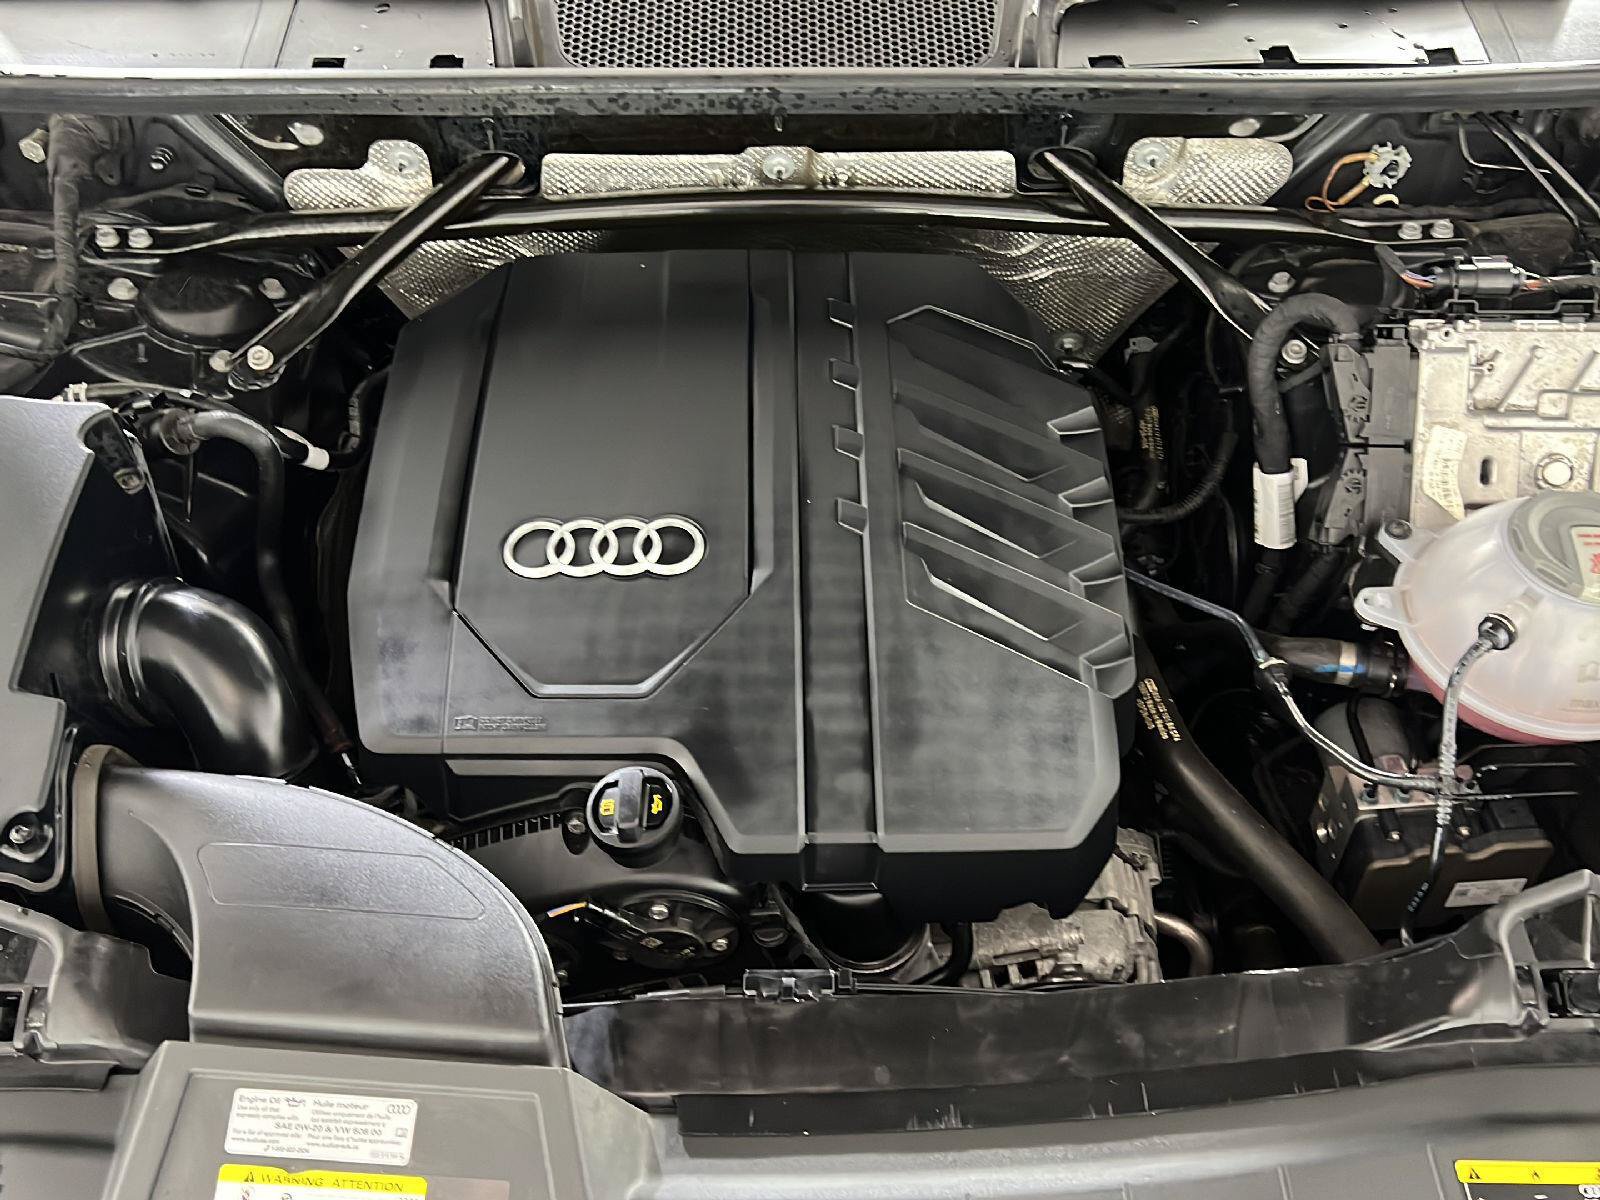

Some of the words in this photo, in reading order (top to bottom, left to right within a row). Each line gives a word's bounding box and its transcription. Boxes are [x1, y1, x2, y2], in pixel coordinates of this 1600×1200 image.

[238, 1094, 268, 1105] Engine
[312, 1098, 335, 1108] Huile
[336, 1101, 370, 1110] moteur
[261, 1173, 324, 1187] WARNING
[332, 1178, 404, 1192] ATTENTION
